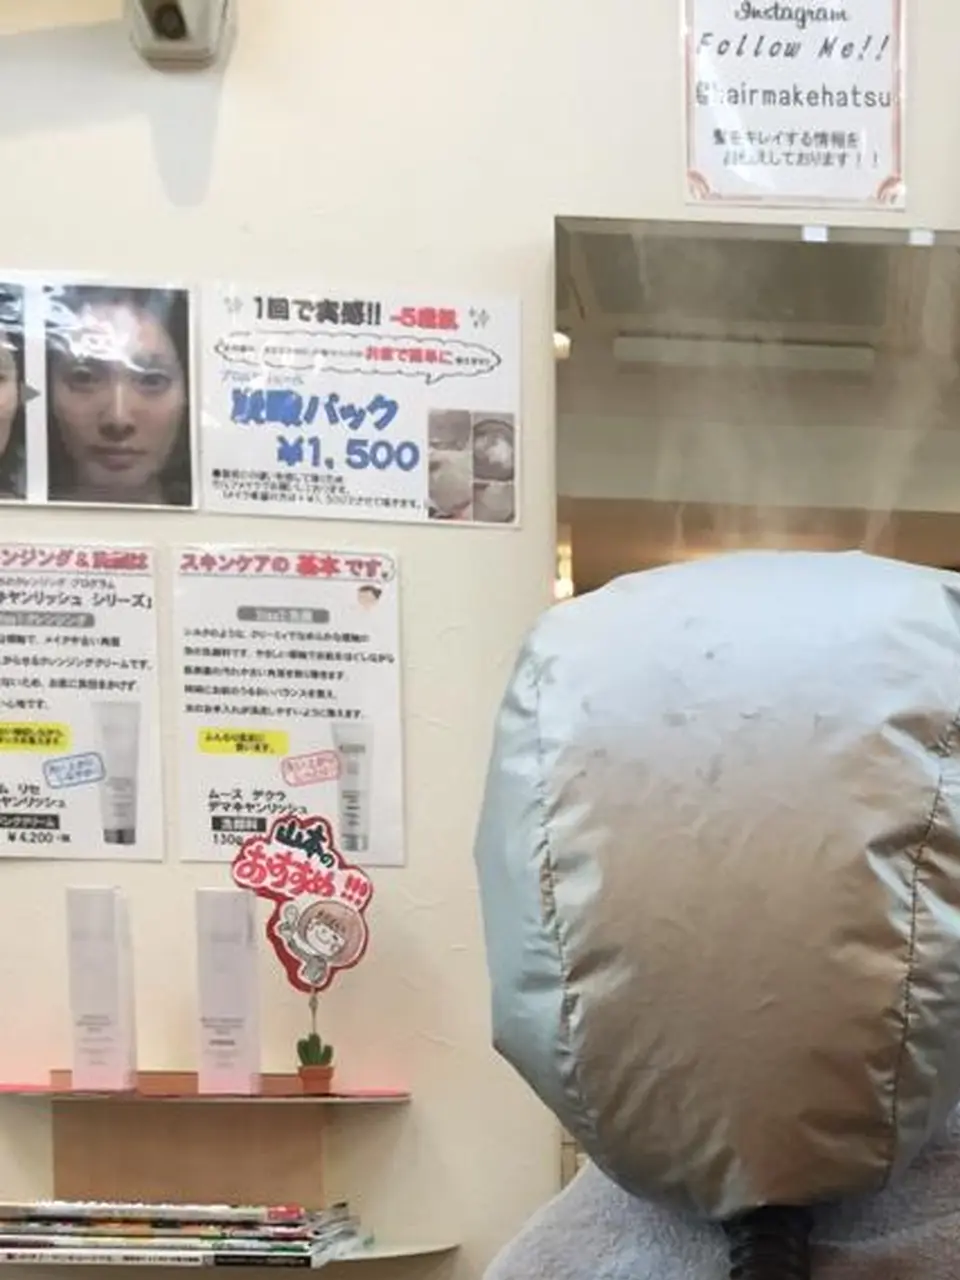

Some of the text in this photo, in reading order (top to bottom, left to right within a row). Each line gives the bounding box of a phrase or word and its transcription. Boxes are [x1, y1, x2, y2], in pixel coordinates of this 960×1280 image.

[735, 1, 848, 29] Instagram
[697, 33, 890, 61] Follow Me!!
